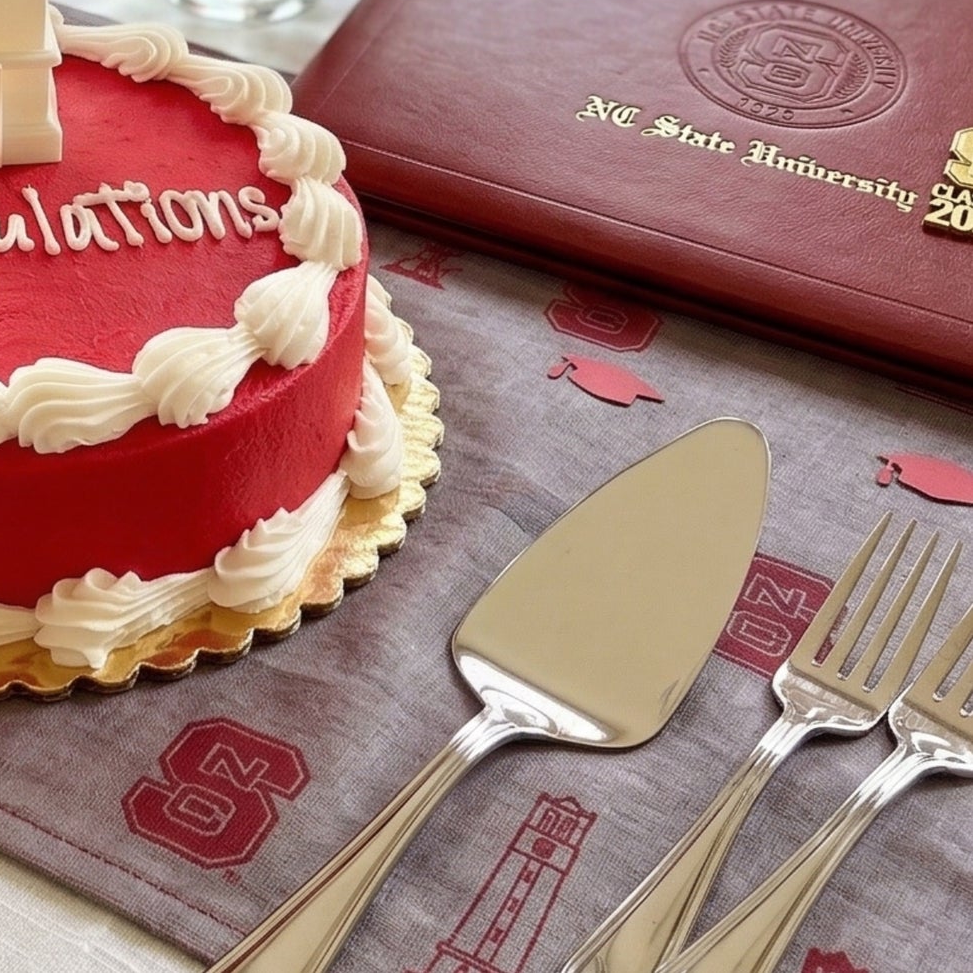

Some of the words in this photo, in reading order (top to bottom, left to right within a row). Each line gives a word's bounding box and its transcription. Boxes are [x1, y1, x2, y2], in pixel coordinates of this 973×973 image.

[575, 94, 643, 128] NC
[639, 114, 737, 154] State
[740, 139, 919, 213] University
[930, 182, 973, 207] CLA
[923, 197, 973, 232] 20
